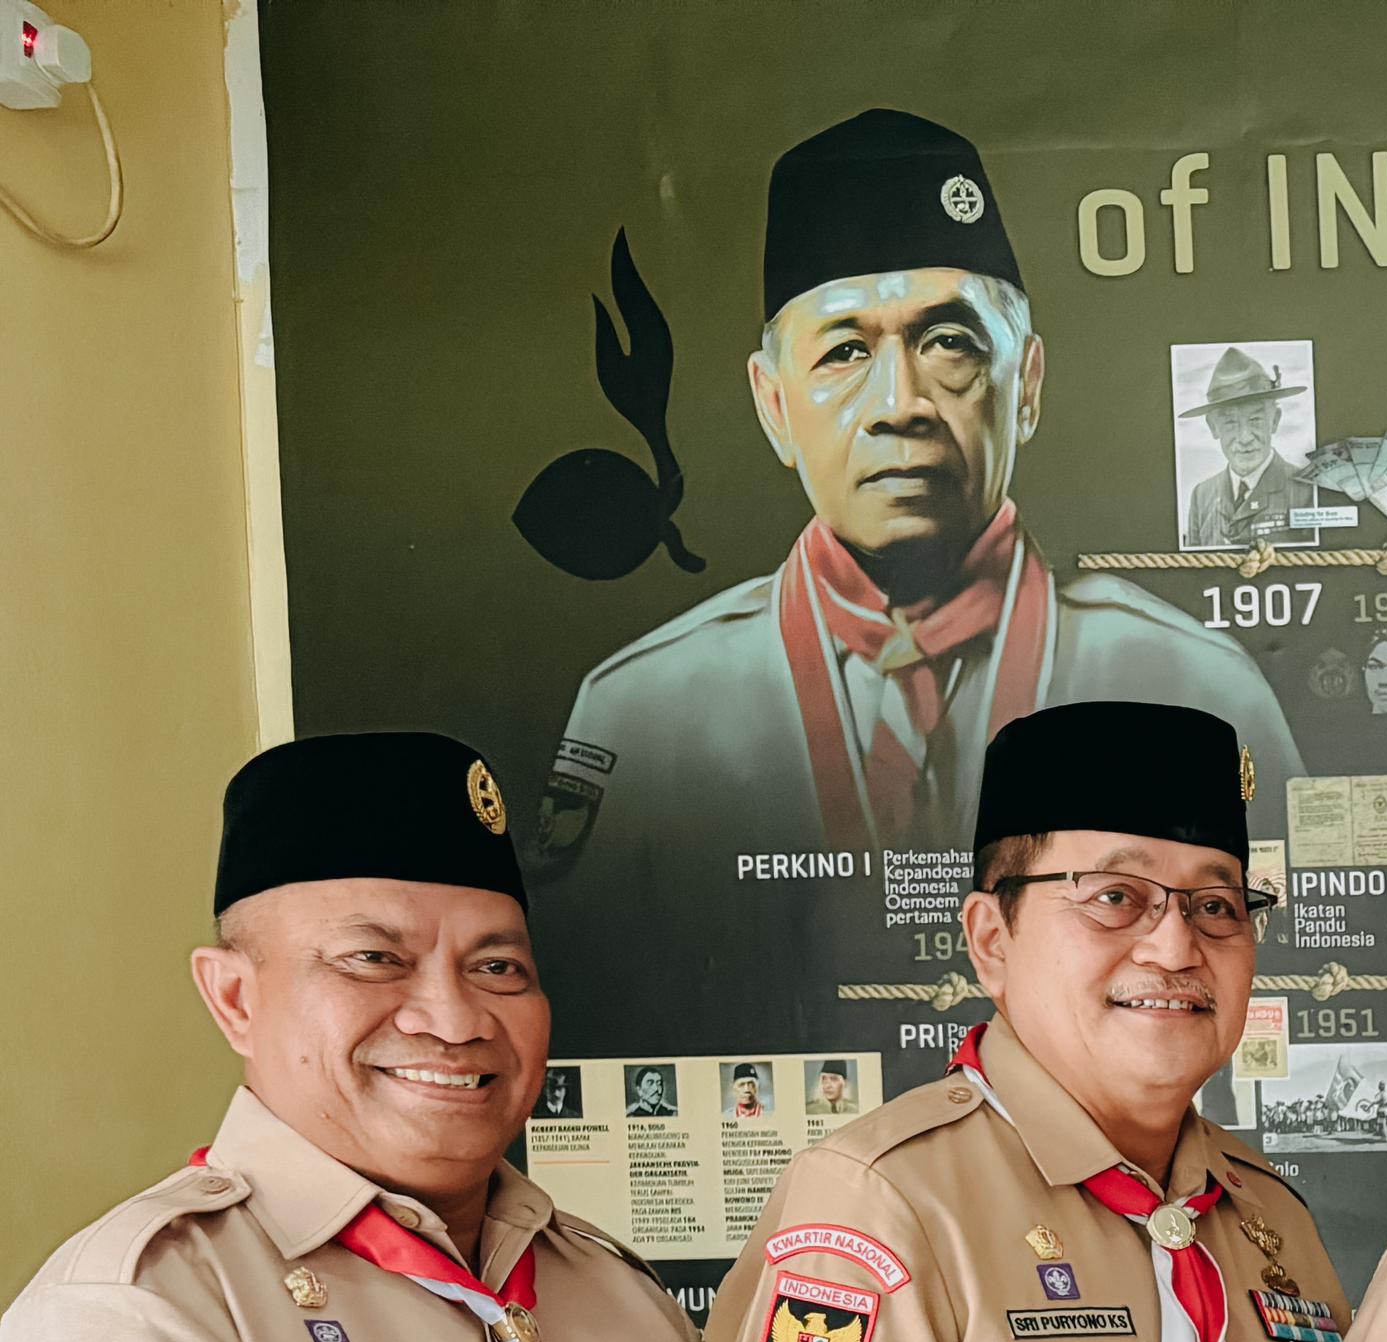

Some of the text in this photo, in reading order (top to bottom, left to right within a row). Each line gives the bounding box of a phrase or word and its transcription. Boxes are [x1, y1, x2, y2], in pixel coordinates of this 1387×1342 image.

[1078, 152, 1210, 277] of
[1202, 582, 1323, 629] 1907
[738, 851, 871, 880] PERKINO I
[885, 880, 959, 895] Indonesia
[1292, 870, 1386, 898] IPINDO
[886, 912, 952, 928] pertama
[1293, 903, 1346, 919] Ikatan
[1294, 917, 1347, 934] Pandu
[1294, 930, 1376, 949] Indonesia
[900, 1023, 944, 1049] PRI
[1296, 1007, 1379, 1039] 1951
[771, 1231, 897, 1282] KWARTIR NASIONAL
[782, 1279, 868, 1308] INDONESIA
[1014, 1312, 1128, 1333] SRI PURYONO KS
